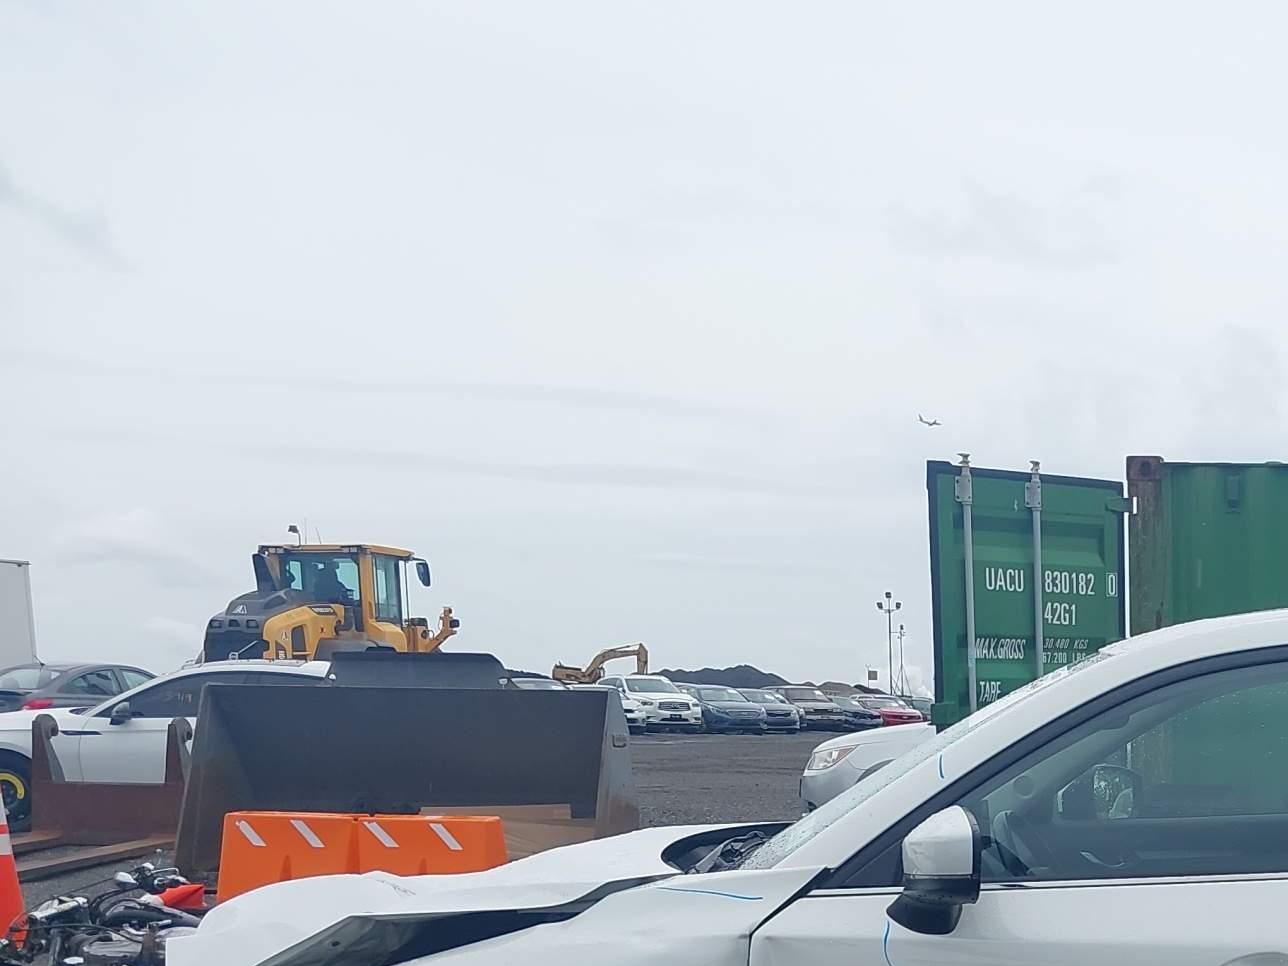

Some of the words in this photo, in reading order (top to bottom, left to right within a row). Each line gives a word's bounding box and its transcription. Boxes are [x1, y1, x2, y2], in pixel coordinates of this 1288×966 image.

[985, 567, 1025, 592] UACU
[1044, 570, 1096, 595] 830182
[1107, 574, 1117, 596] 0
[1044, 602, 1076, 625] 42G1
[1074, 639, 1089, 650] KGS
